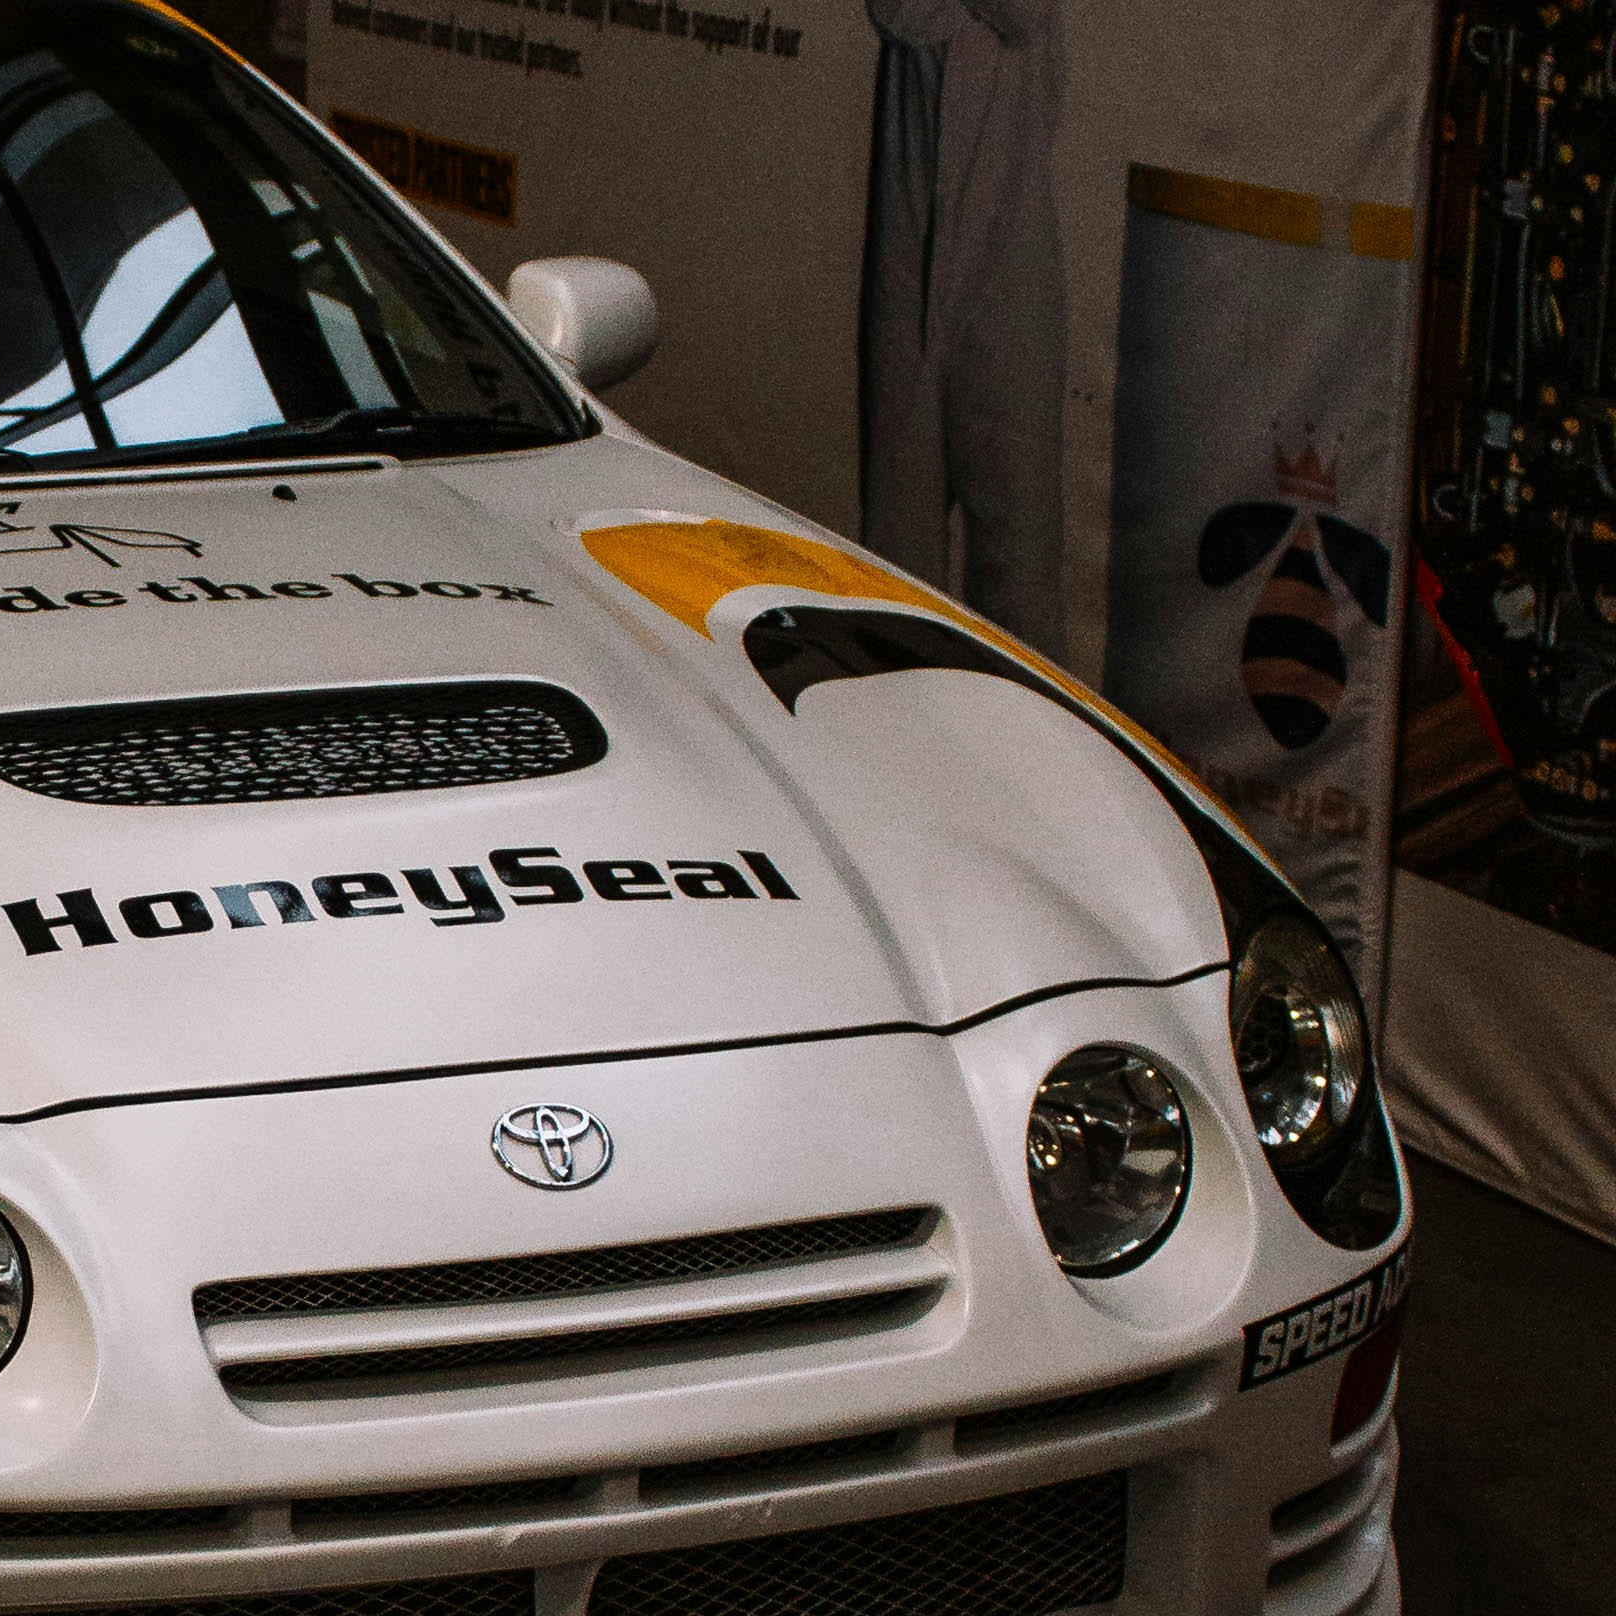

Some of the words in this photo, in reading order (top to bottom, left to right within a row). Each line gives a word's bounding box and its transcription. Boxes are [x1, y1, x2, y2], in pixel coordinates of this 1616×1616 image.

[139, 576, 333, 604] the
[333, 573, 552, 606] box
[2, 846, 801, 957] HoneySeal
[1250, 1279, 1374, 1378] SPEED
